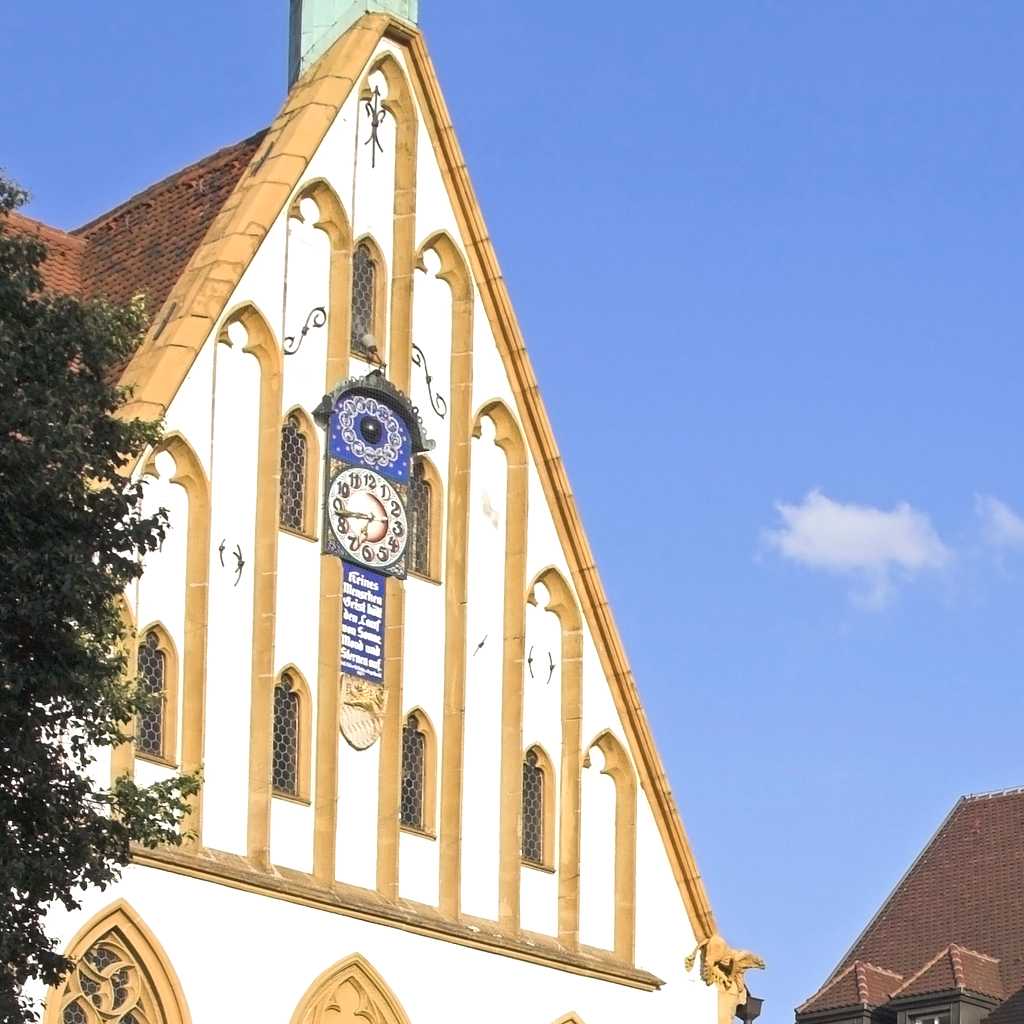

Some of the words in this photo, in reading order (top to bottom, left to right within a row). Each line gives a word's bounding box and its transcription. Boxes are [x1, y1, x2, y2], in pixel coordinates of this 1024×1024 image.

[337, 480, 350, 498] 10
[363, 473, 376, 489] 12
[391, 501, 402, 518] 2
[392, 521, 404, 537] 3
[388, 537, 400, 553] 4
[362, 545, 375, 562] 6
[377, 546, 390, 562] 5
